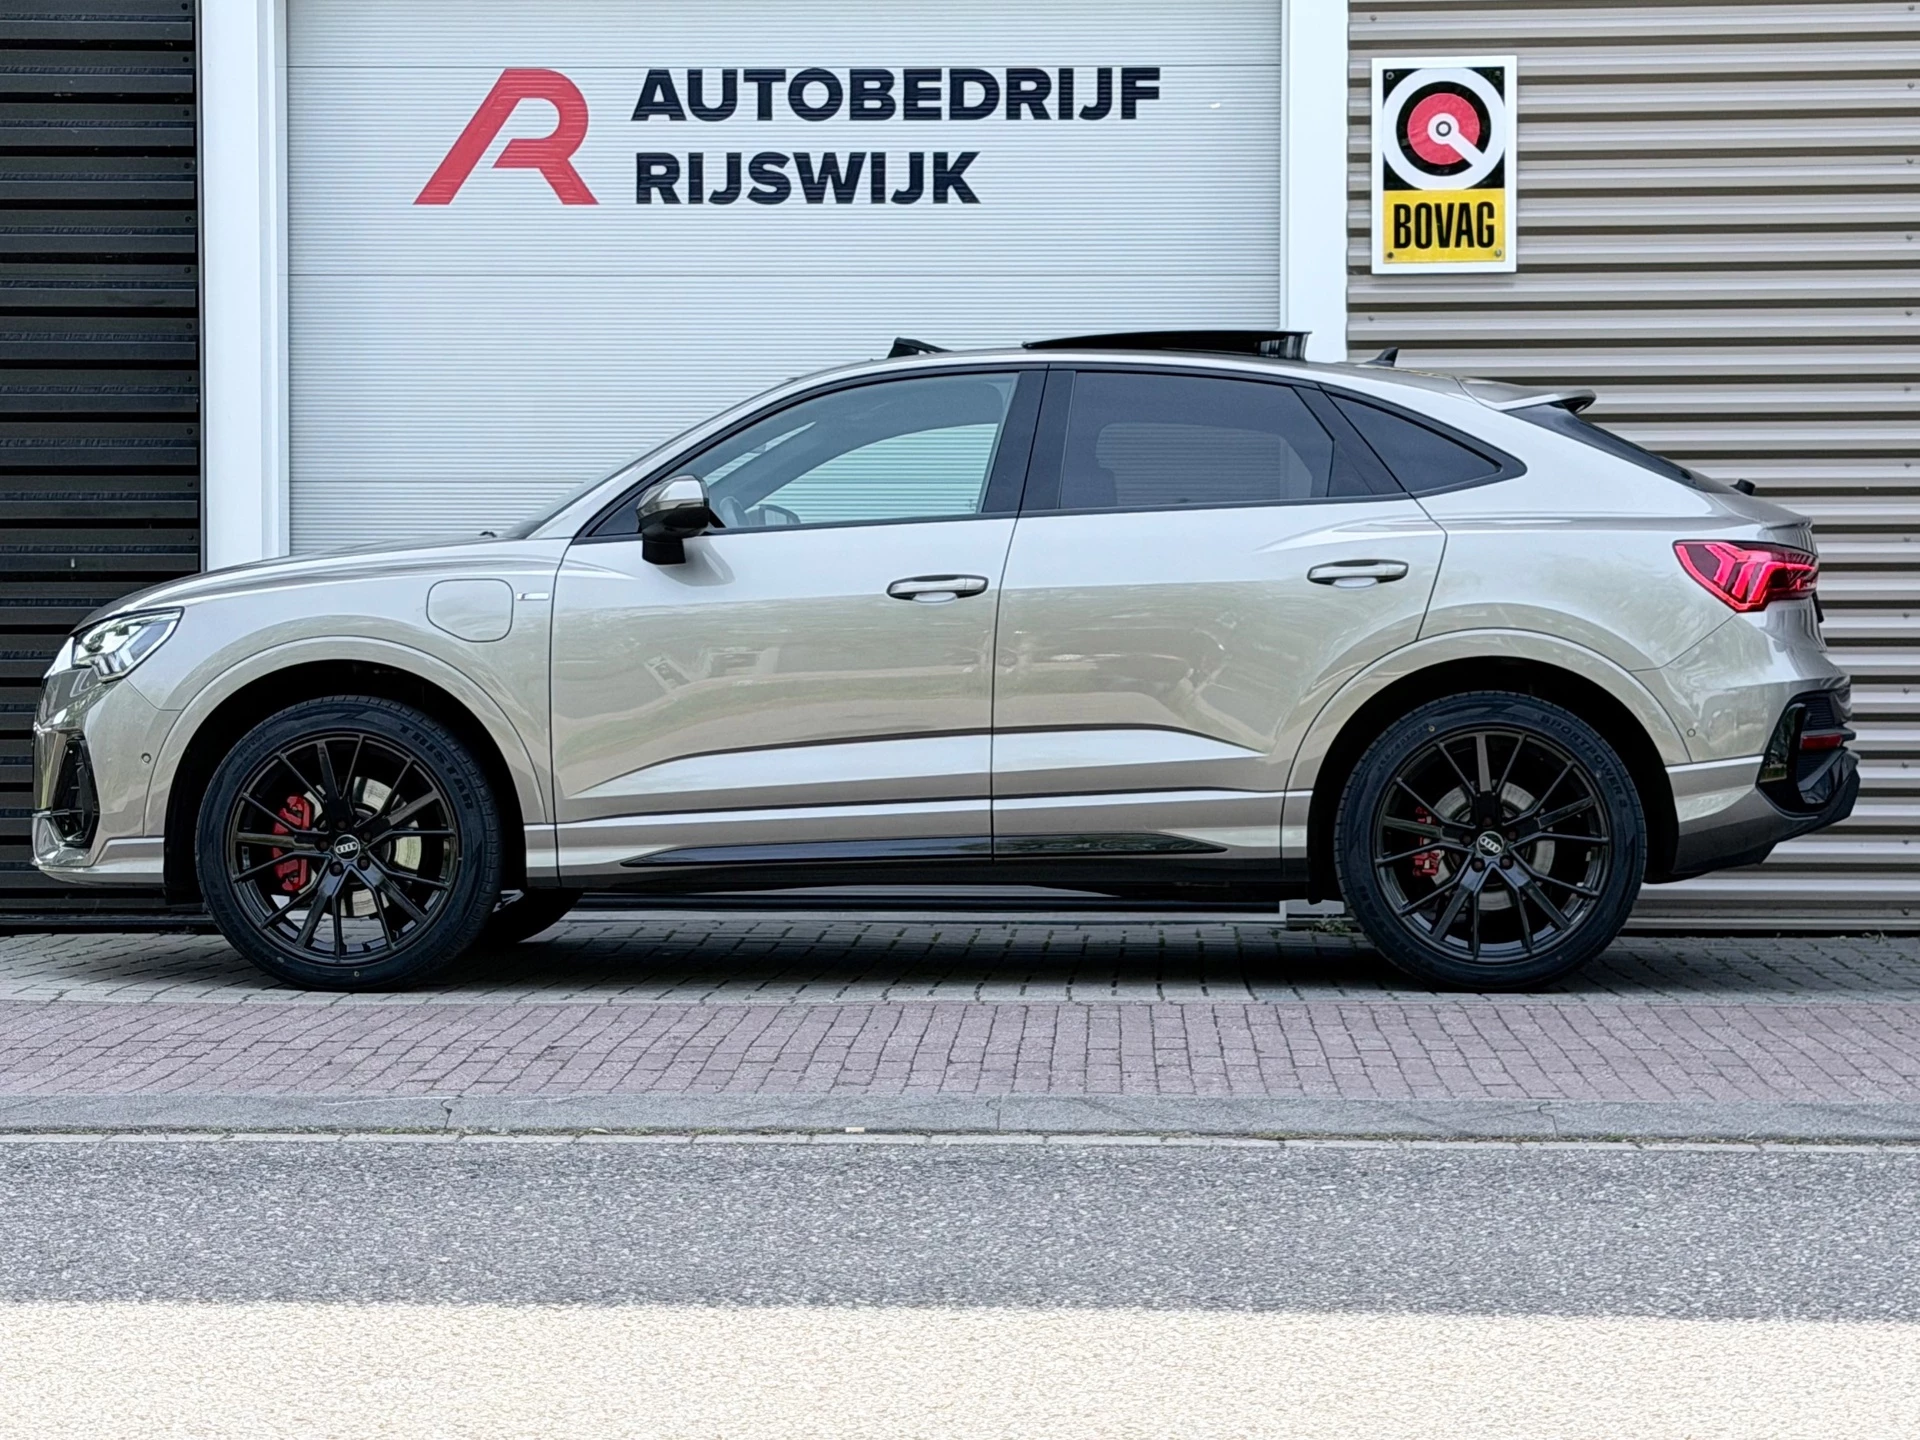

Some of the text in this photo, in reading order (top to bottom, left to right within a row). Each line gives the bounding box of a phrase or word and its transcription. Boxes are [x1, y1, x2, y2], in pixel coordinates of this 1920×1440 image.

[632, 68, 1160, 121] AUTOBEDRIJF
[637, 152, 978, 204] RIJSWIJK
[1394, 202, 1494, 249] BOVAG
[396, 723, 476, 810] TRISTAR
[1540, 713, 1622, 796] SPORTPOWER
